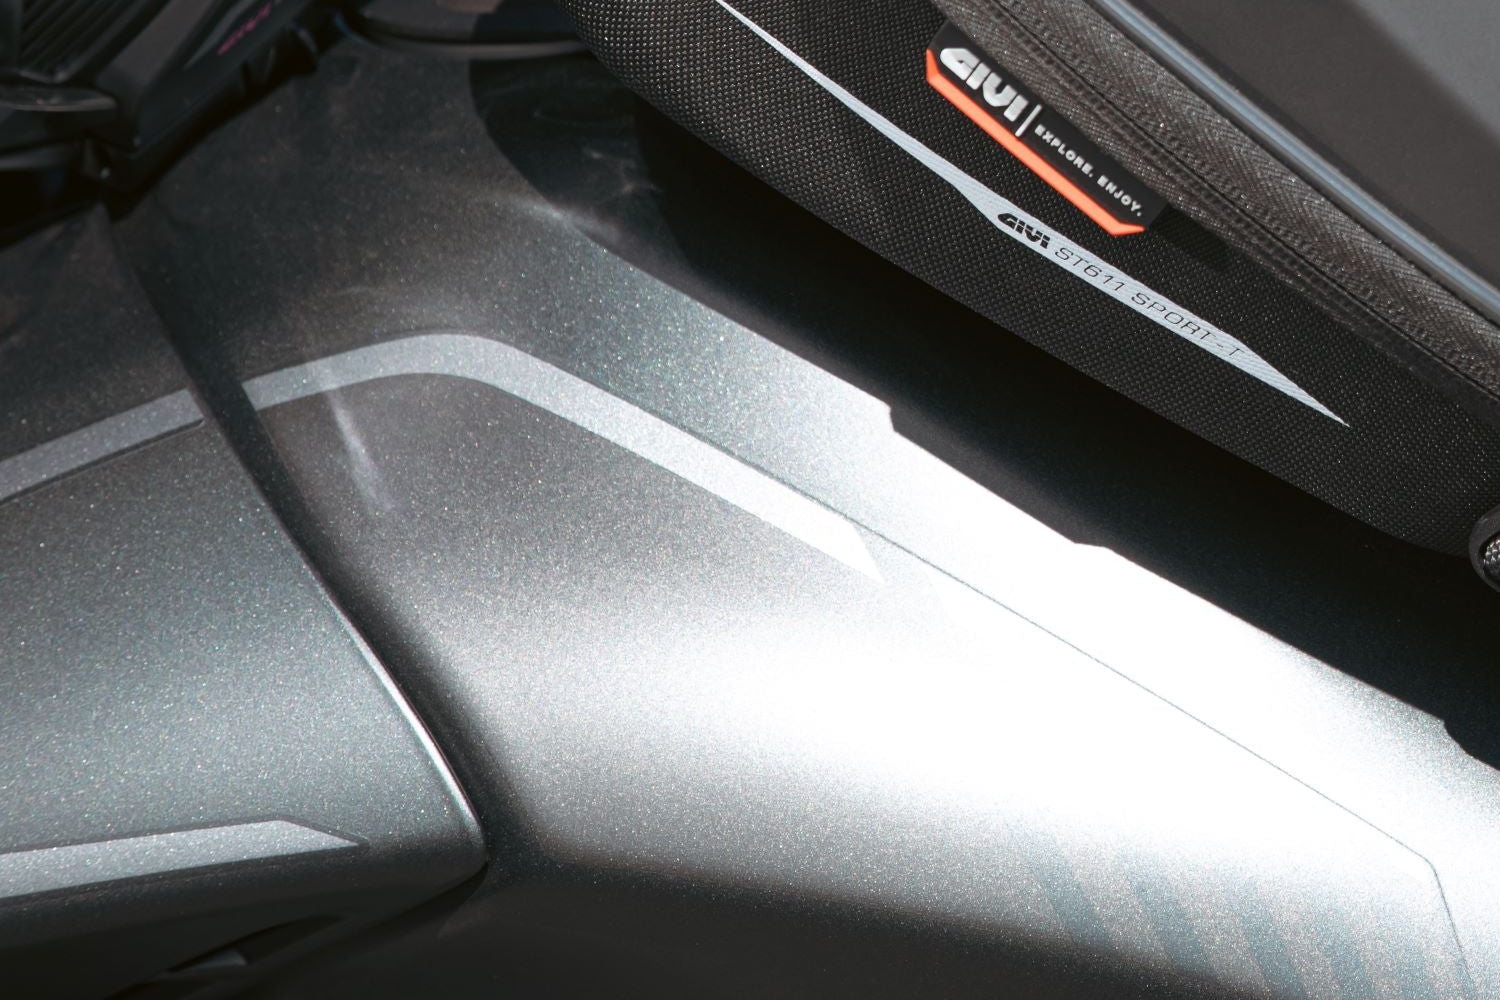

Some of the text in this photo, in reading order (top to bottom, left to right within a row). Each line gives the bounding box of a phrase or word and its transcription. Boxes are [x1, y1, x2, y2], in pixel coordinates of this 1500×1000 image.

[940, 47, 1142, 217] GIVI EXPLORE. ENJOY.
[997, 212, 1245, 356] GIVI ST611 SPORT-T
